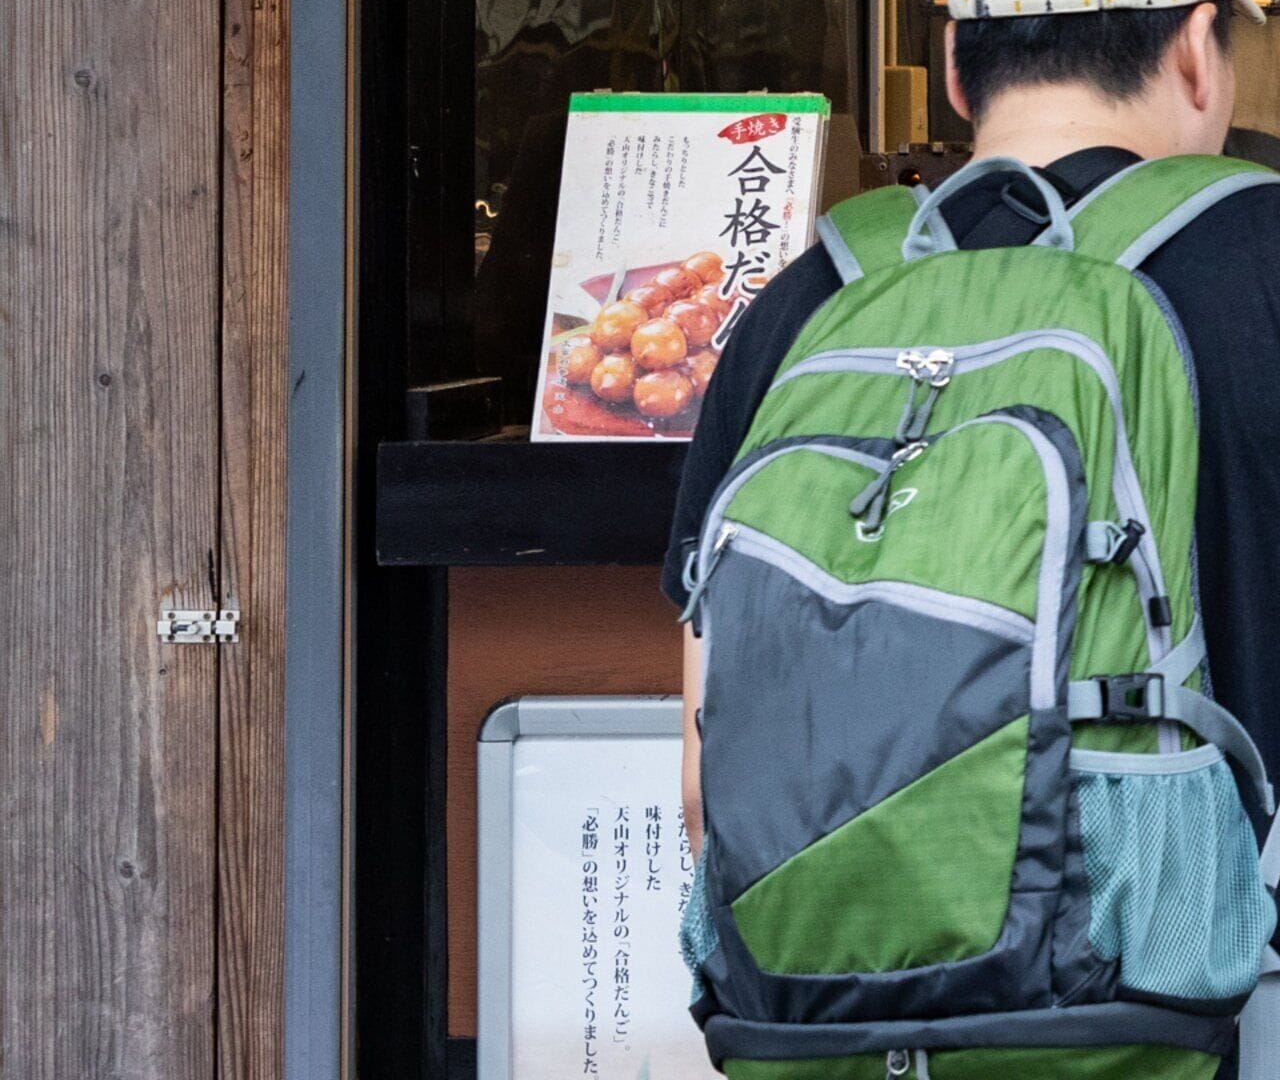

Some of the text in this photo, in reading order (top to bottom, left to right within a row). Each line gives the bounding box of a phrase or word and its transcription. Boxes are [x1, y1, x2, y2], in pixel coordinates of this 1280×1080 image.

[730, 116, 781, 141] 手焼き
[645, 805, 662, 892] 味付けした
